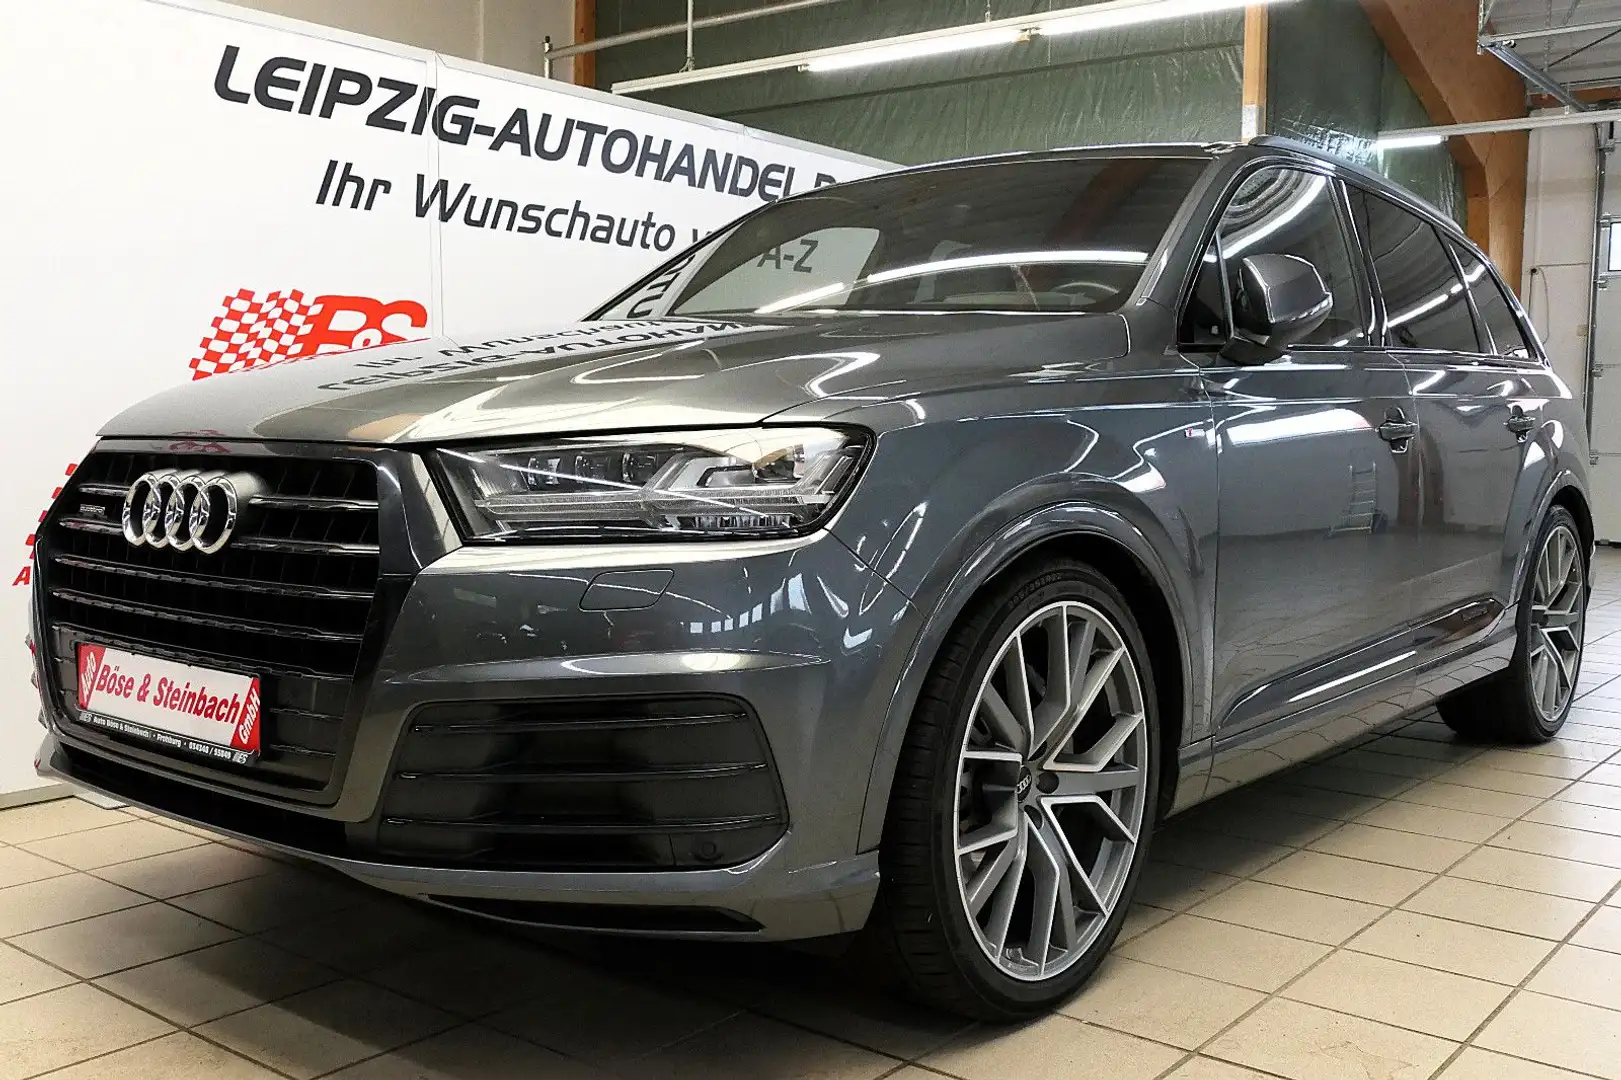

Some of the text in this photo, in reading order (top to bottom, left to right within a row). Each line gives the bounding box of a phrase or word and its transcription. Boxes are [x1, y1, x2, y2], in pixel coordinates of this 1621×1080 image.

[214, 45, 796, 202] LEIPZIG-AUTOHANDEL
[315, 159, 818, 274] Ihr Wunschauto A-Z
[95, 664, 241, 724] Böse & Steinbach
[238, 688, 261, 745] GmbH
